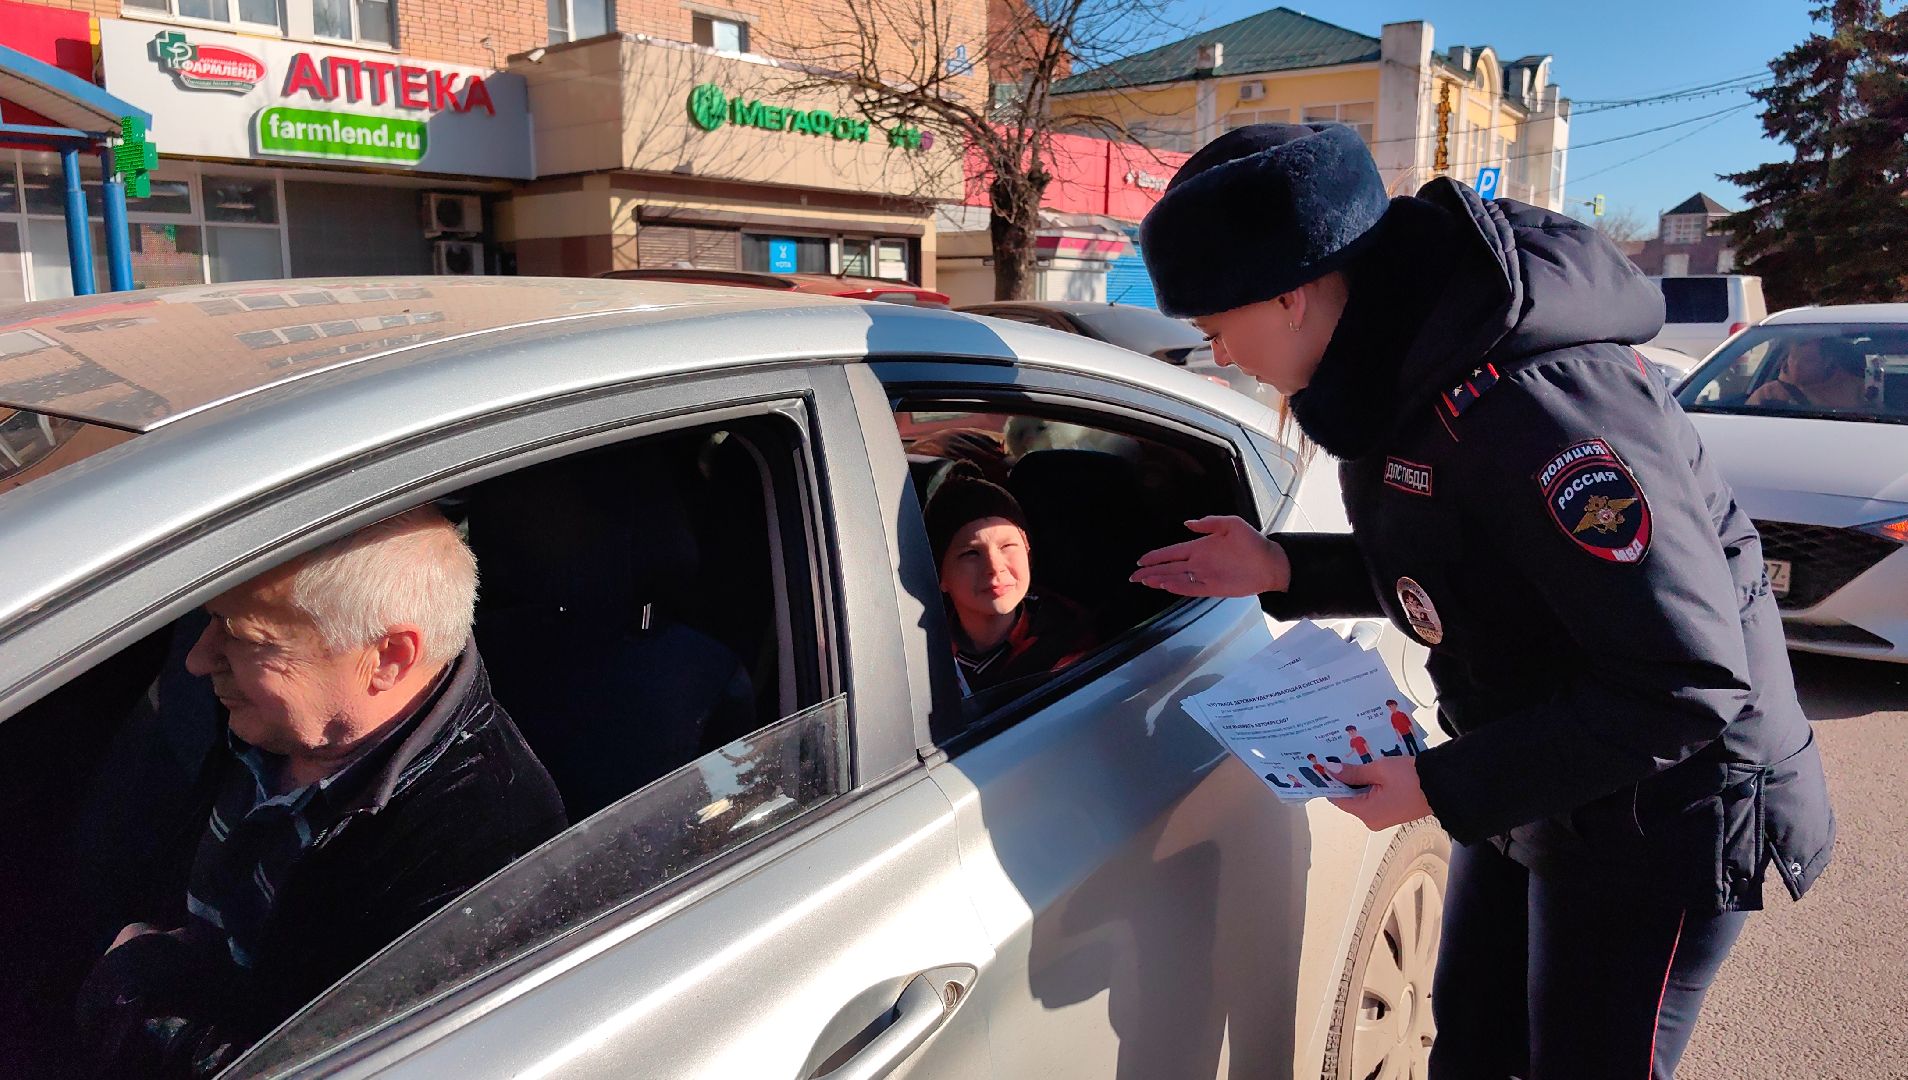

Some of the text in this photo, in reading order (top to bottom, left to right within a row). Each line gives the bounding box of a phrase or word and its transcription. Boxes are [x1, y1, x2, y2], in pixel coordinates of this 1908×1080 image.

[182, 60, 258, 79] ФАРМЛЕНД
[283, 52, 496, 117] АПТЕКА
[269, 113, 421, 150] farmlend.ru
[1541, 444, 1606, 486] ПОЛИЦИЯ
[1558, 471, 1618, 510] РОССИЯ
[1611, 538, 1643, 561] МВД
